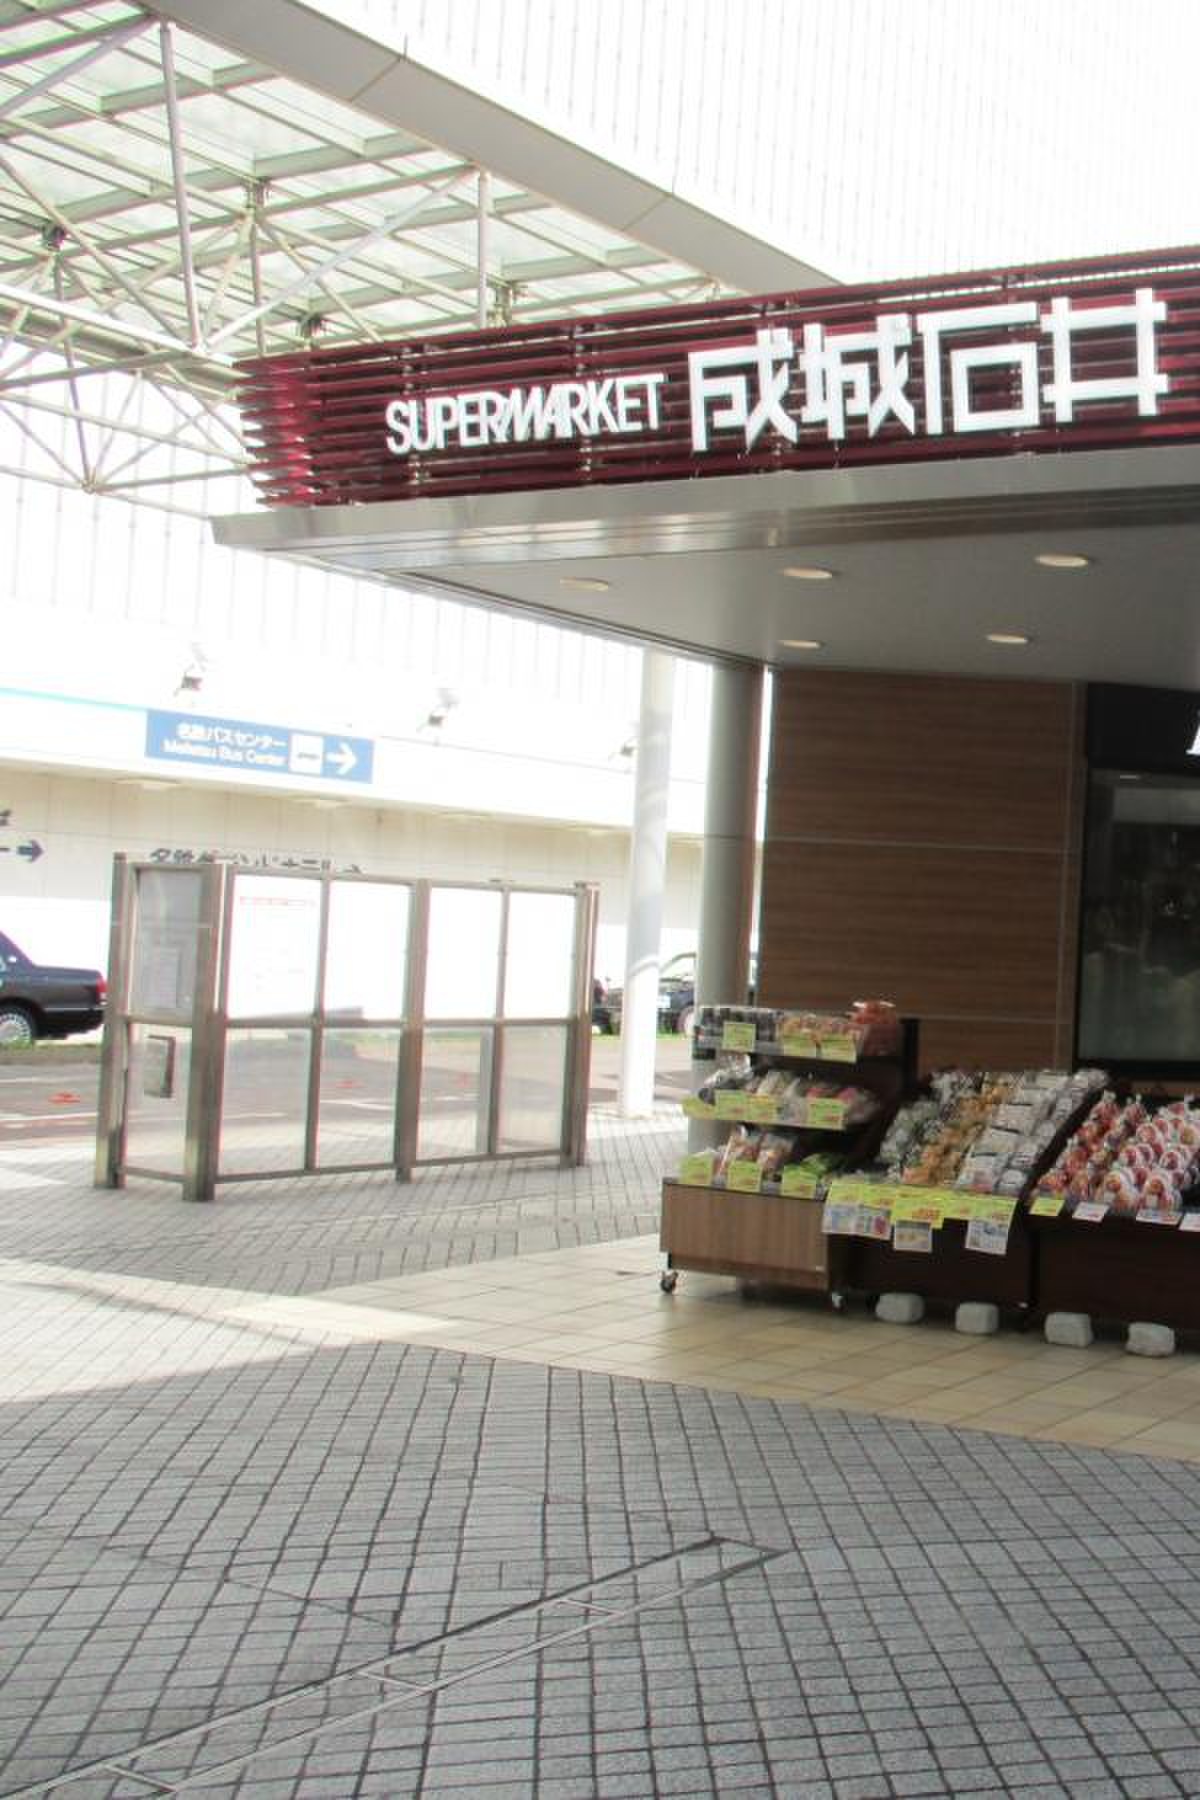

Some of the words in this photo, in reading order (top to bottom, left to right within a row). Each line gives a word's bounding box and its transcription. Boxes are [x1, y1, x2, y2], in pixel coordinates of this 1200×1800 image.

[384, 372, 665, 457] SUPERMARKET
[686, 286, 1170, 455] 成城石井
